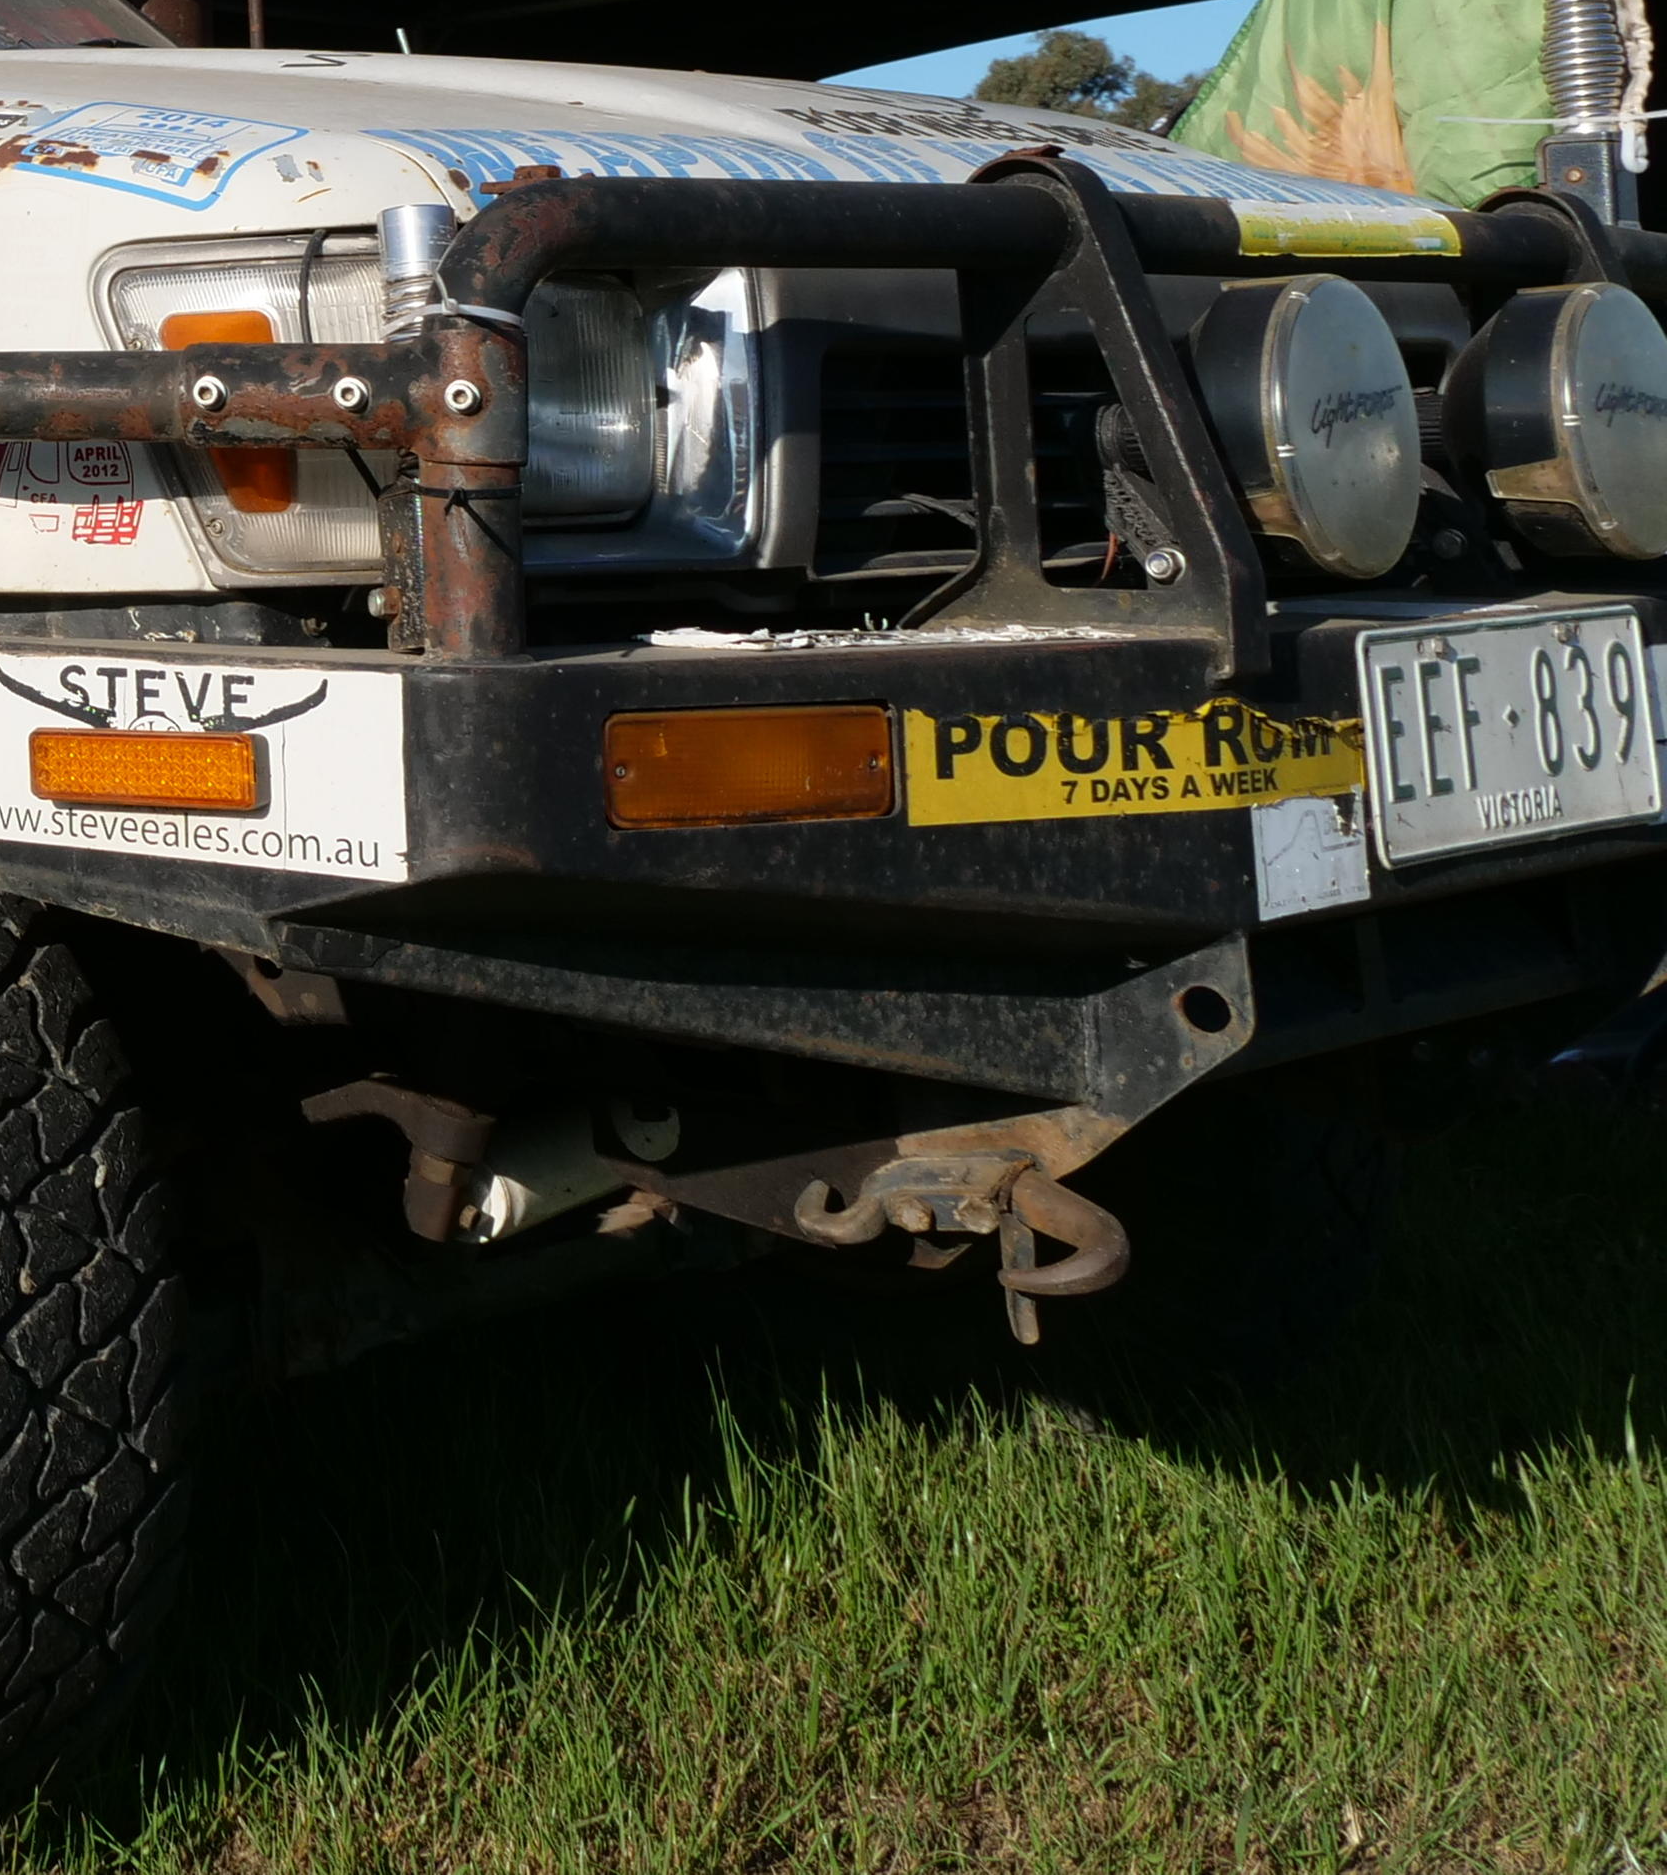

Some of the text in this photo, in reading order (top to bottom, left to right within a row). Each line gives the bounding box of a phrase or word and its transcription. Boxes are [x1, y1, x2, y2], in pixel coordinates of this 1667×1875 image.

[136, 110, 232, 129] 2014
[80, 128, 201, 148] HEATHCOTE
[74, 445, 122, 462] APRIL
[82, 464, 119, 478] 2012
[30, 493, 58, 504] CFA
[58, 662, 256, 721] STEVE
[934, 710, 1174, 781] POUR
[1061, 767, 1279, 806] 7 DAYS A WEEK
[1476, 783, 1565, 831] VICTORIA
